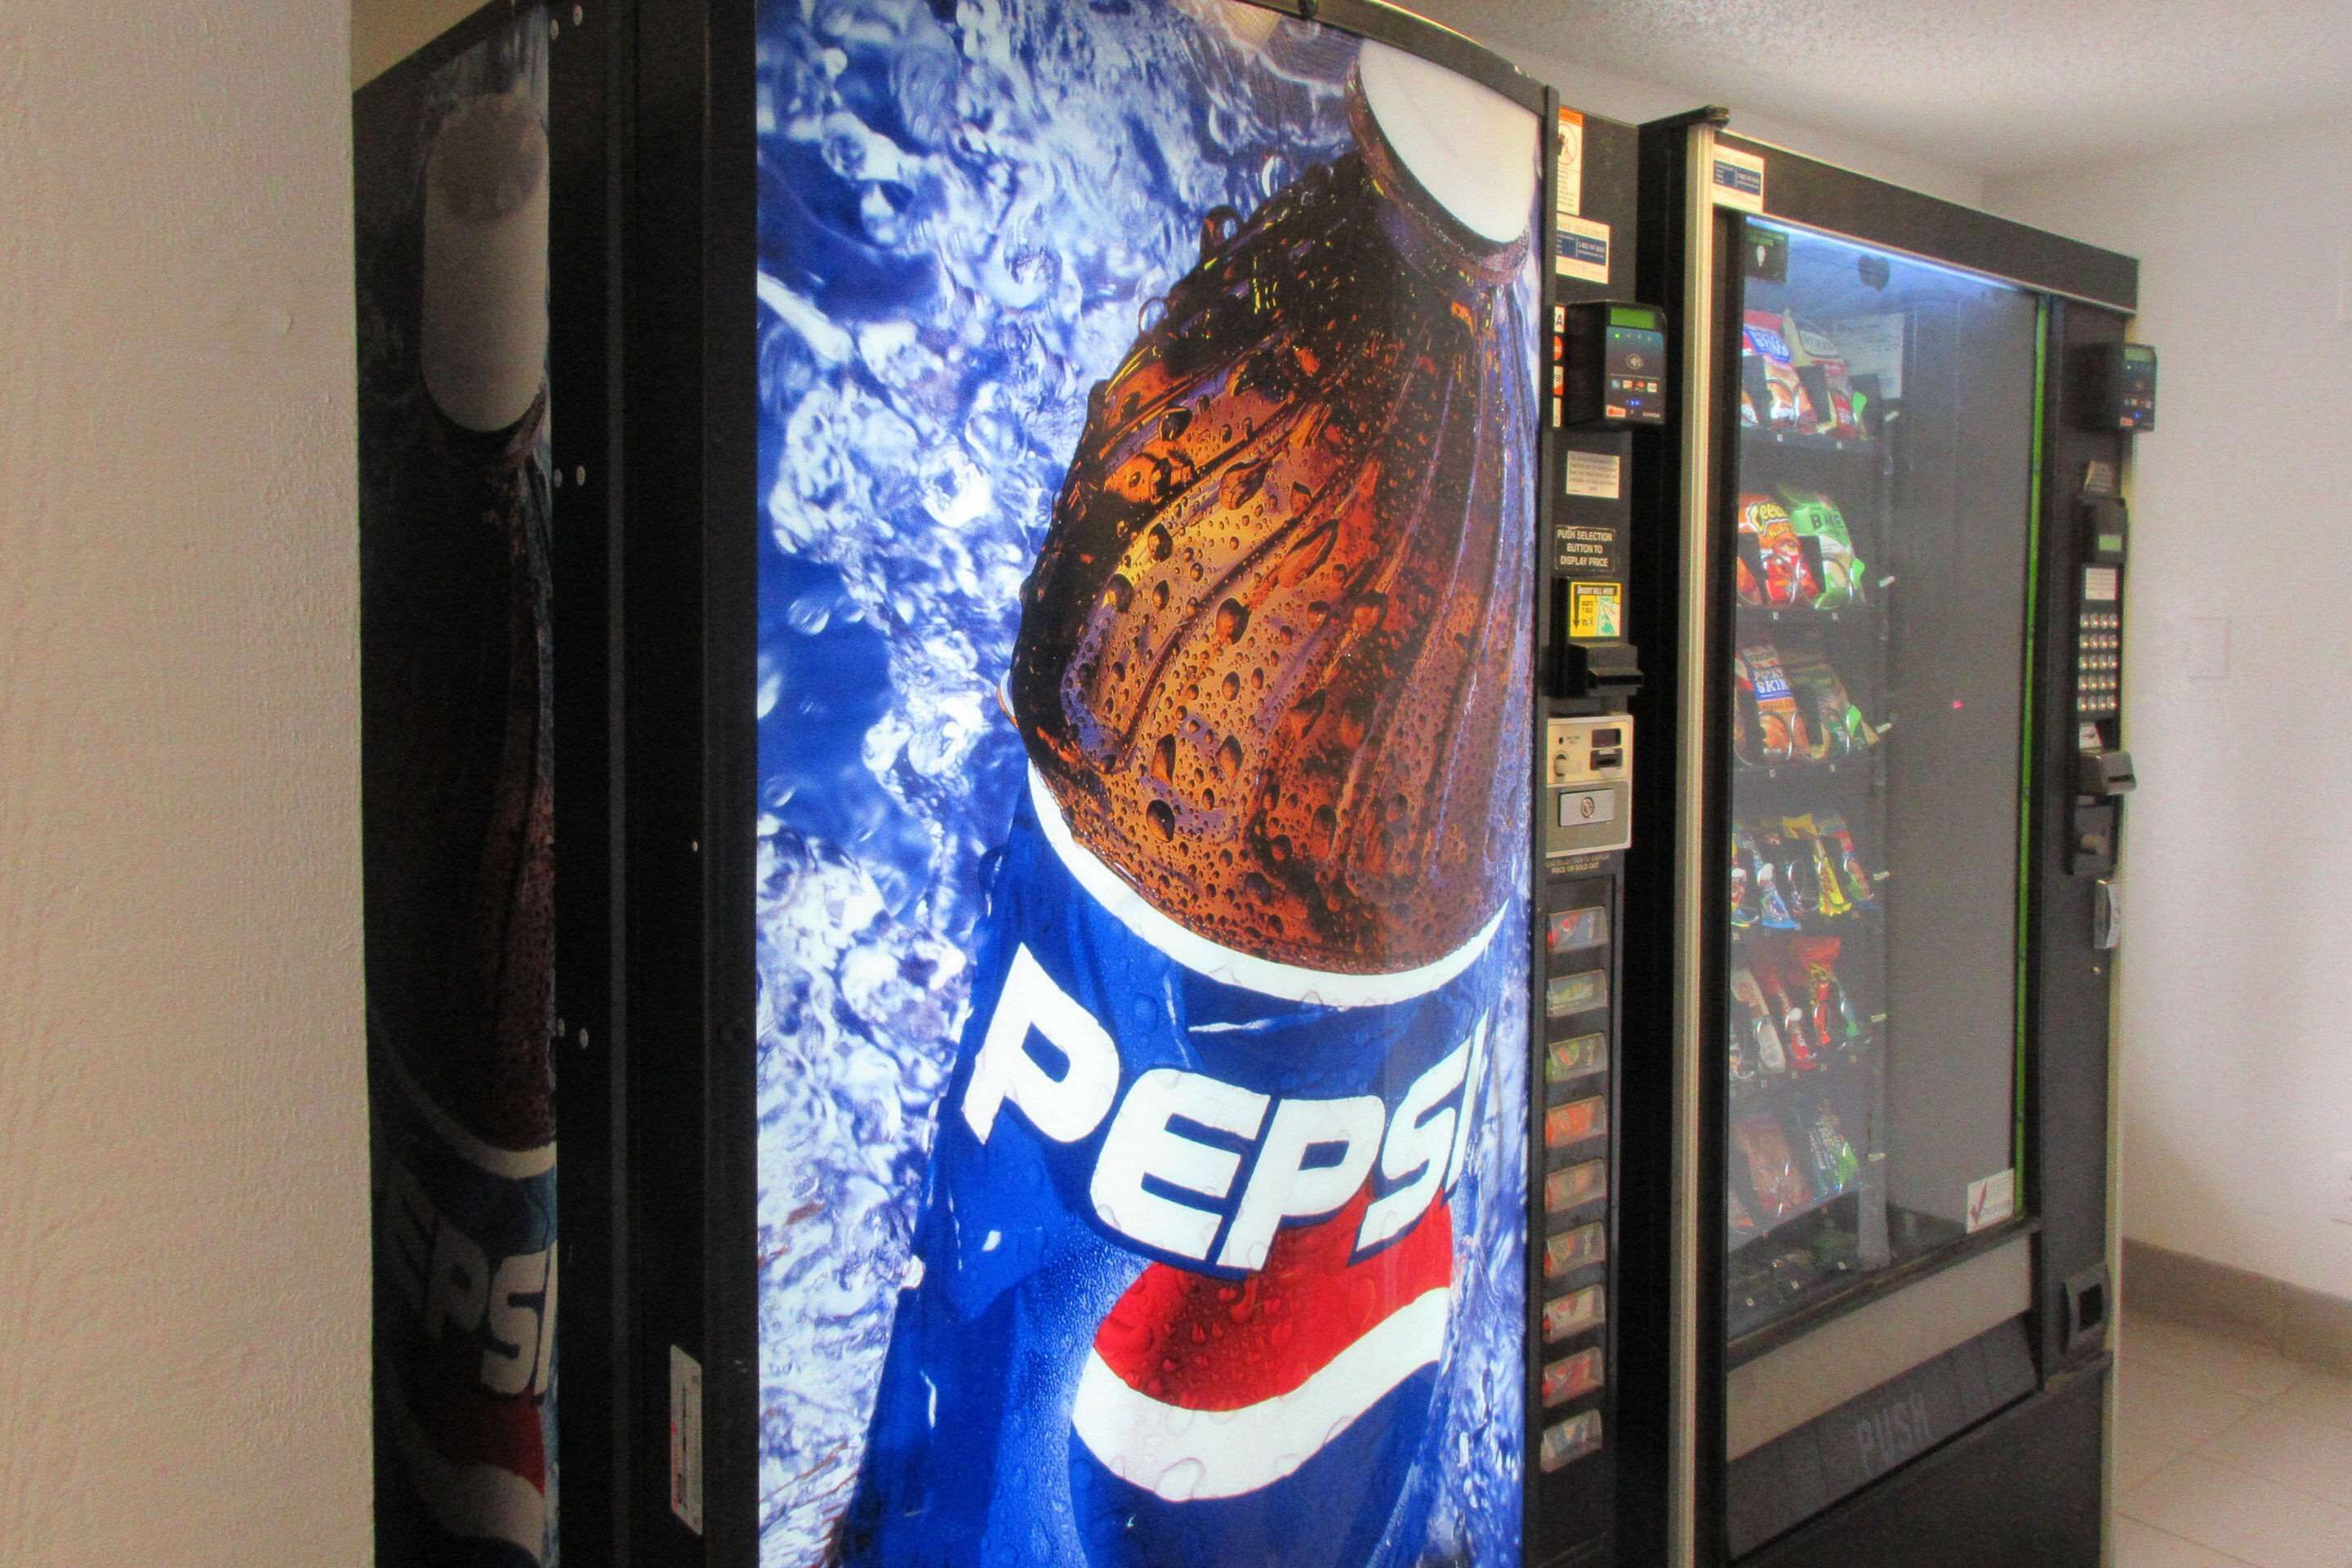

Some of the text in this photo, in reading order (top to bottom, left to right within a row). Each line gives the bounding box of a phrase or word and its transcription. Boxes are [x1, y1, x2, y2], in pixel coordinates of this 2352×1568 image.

[1557, 528, 1613, 541] PUSH SELECTION
[1566, 542, 1604, 555] BUTTON TO
[1560, 555, 1608, 567] DISPLAY PRICE
[962, 942, 1488, 1271] PEPSI
